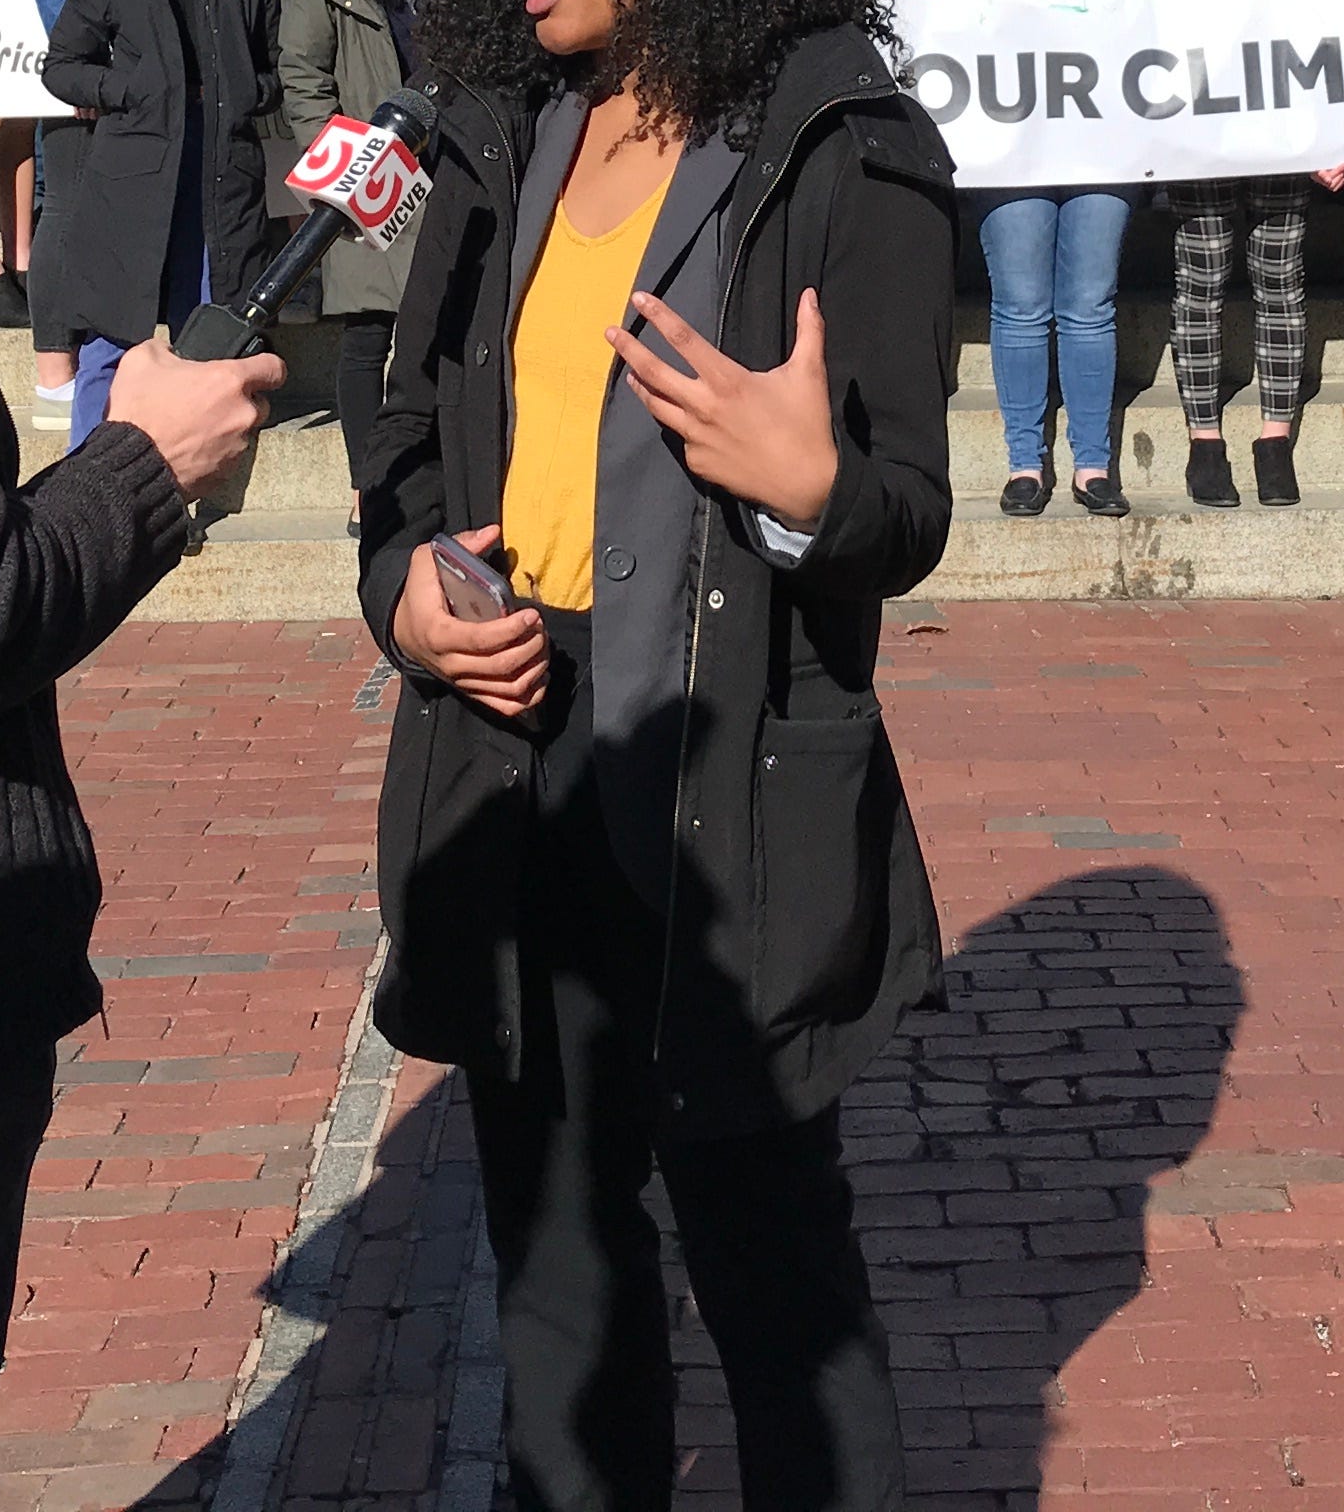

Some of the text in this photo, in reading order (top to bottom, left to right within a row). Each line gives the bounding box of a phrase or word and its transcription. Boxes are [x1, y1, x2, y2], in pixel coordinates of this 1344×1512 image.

[912, 51, 1100, 125] OUR
[333, 137, 386, 194] WCVB
[379, 181, 427, 243] WCVB
